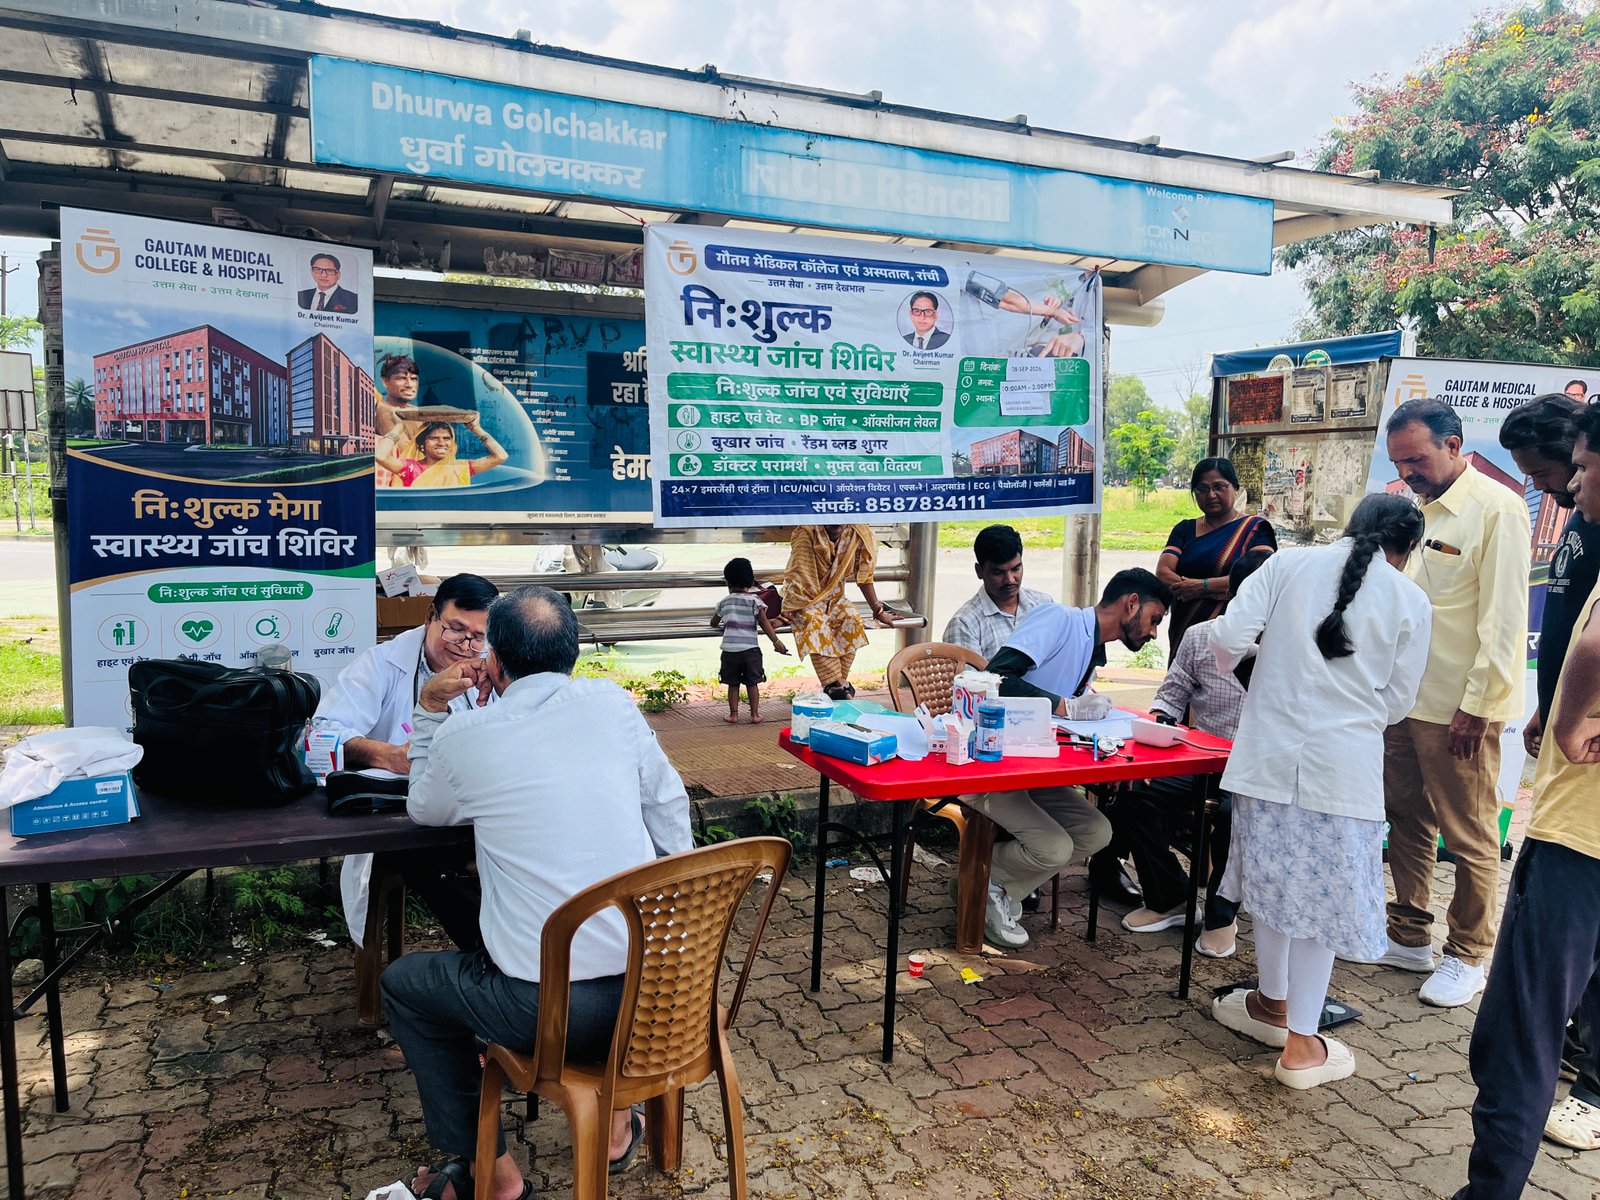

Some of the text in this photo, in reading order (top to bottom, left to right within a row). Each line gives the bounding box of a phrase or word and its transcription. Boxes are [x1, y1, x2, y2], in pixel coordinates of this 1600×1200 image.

[372, 81, 667, 150] Dhurwa Golchakkar
[400, 133, 645, 190] धुर्वा गोलचक्कर
[877, 170, 1009, 222] Ranchi
[1146, 187, 1211, 204] Welcome By
[144, 238, 274, 267] GAUTAM MEDICAL
[135, 254, 284, 285] COLLEGE & HOSPITAL
[716, 250, 940, 282] गौतम मेडिकल कॉलेज एवं अस्पताल, रांची
[152, 280, 270, 300] उत्तम सेवा उत्तम देखभाल
[768, 278, 865, 293] उत्तम सेवा उत्तम देखभाल
[309, 313, 334, 321] Avijeet
[336, 316, 359, 324] Kumar
[669, 340, 897, 372] स्वास्थ्य जांच शिविर
[902, 350, 911, 358] Dr.
[912, 351, 934, 359] Avijeet
[611, 381, 640, 404] रहा
[785, 381, 820, 399] जांच
[825, 384, 848, 402] एवं
[1445, 379, 1537, 396] GAUTAM MEDICAL
[1481, 397, 1490, 408] &
[1493, 397, 1530, 409] HOSPI
[710, 410, 938, 428] हाइट एवं वेट BP जांच ऑक्सीजन लेवल
[711, 435, 888, 453] बुखार जांच रैंडम ब्लड शुगर
[610, 445, 652, 480] हेम
[712, 457, 922, 475] डॉक्टर परामर्श मुफ्त दवा वितरण
[737, 484, 749, 494] एवं
[780, 484, 826, 494] ICU/NICU
[973, 482, 990, 490] ECG
[267, 492, 322, 521] मेगा
[865, 495, 986, 512] 8587834111
[90, 525, 358, 558] स्वास्थ्य जाँच शिविर
[241, 585, 257, 596] एवं
[313, 648, 335, 658] बुखार
[97, 658, 119, 668] हाइट
[121, 657, 134, 665] एवं
